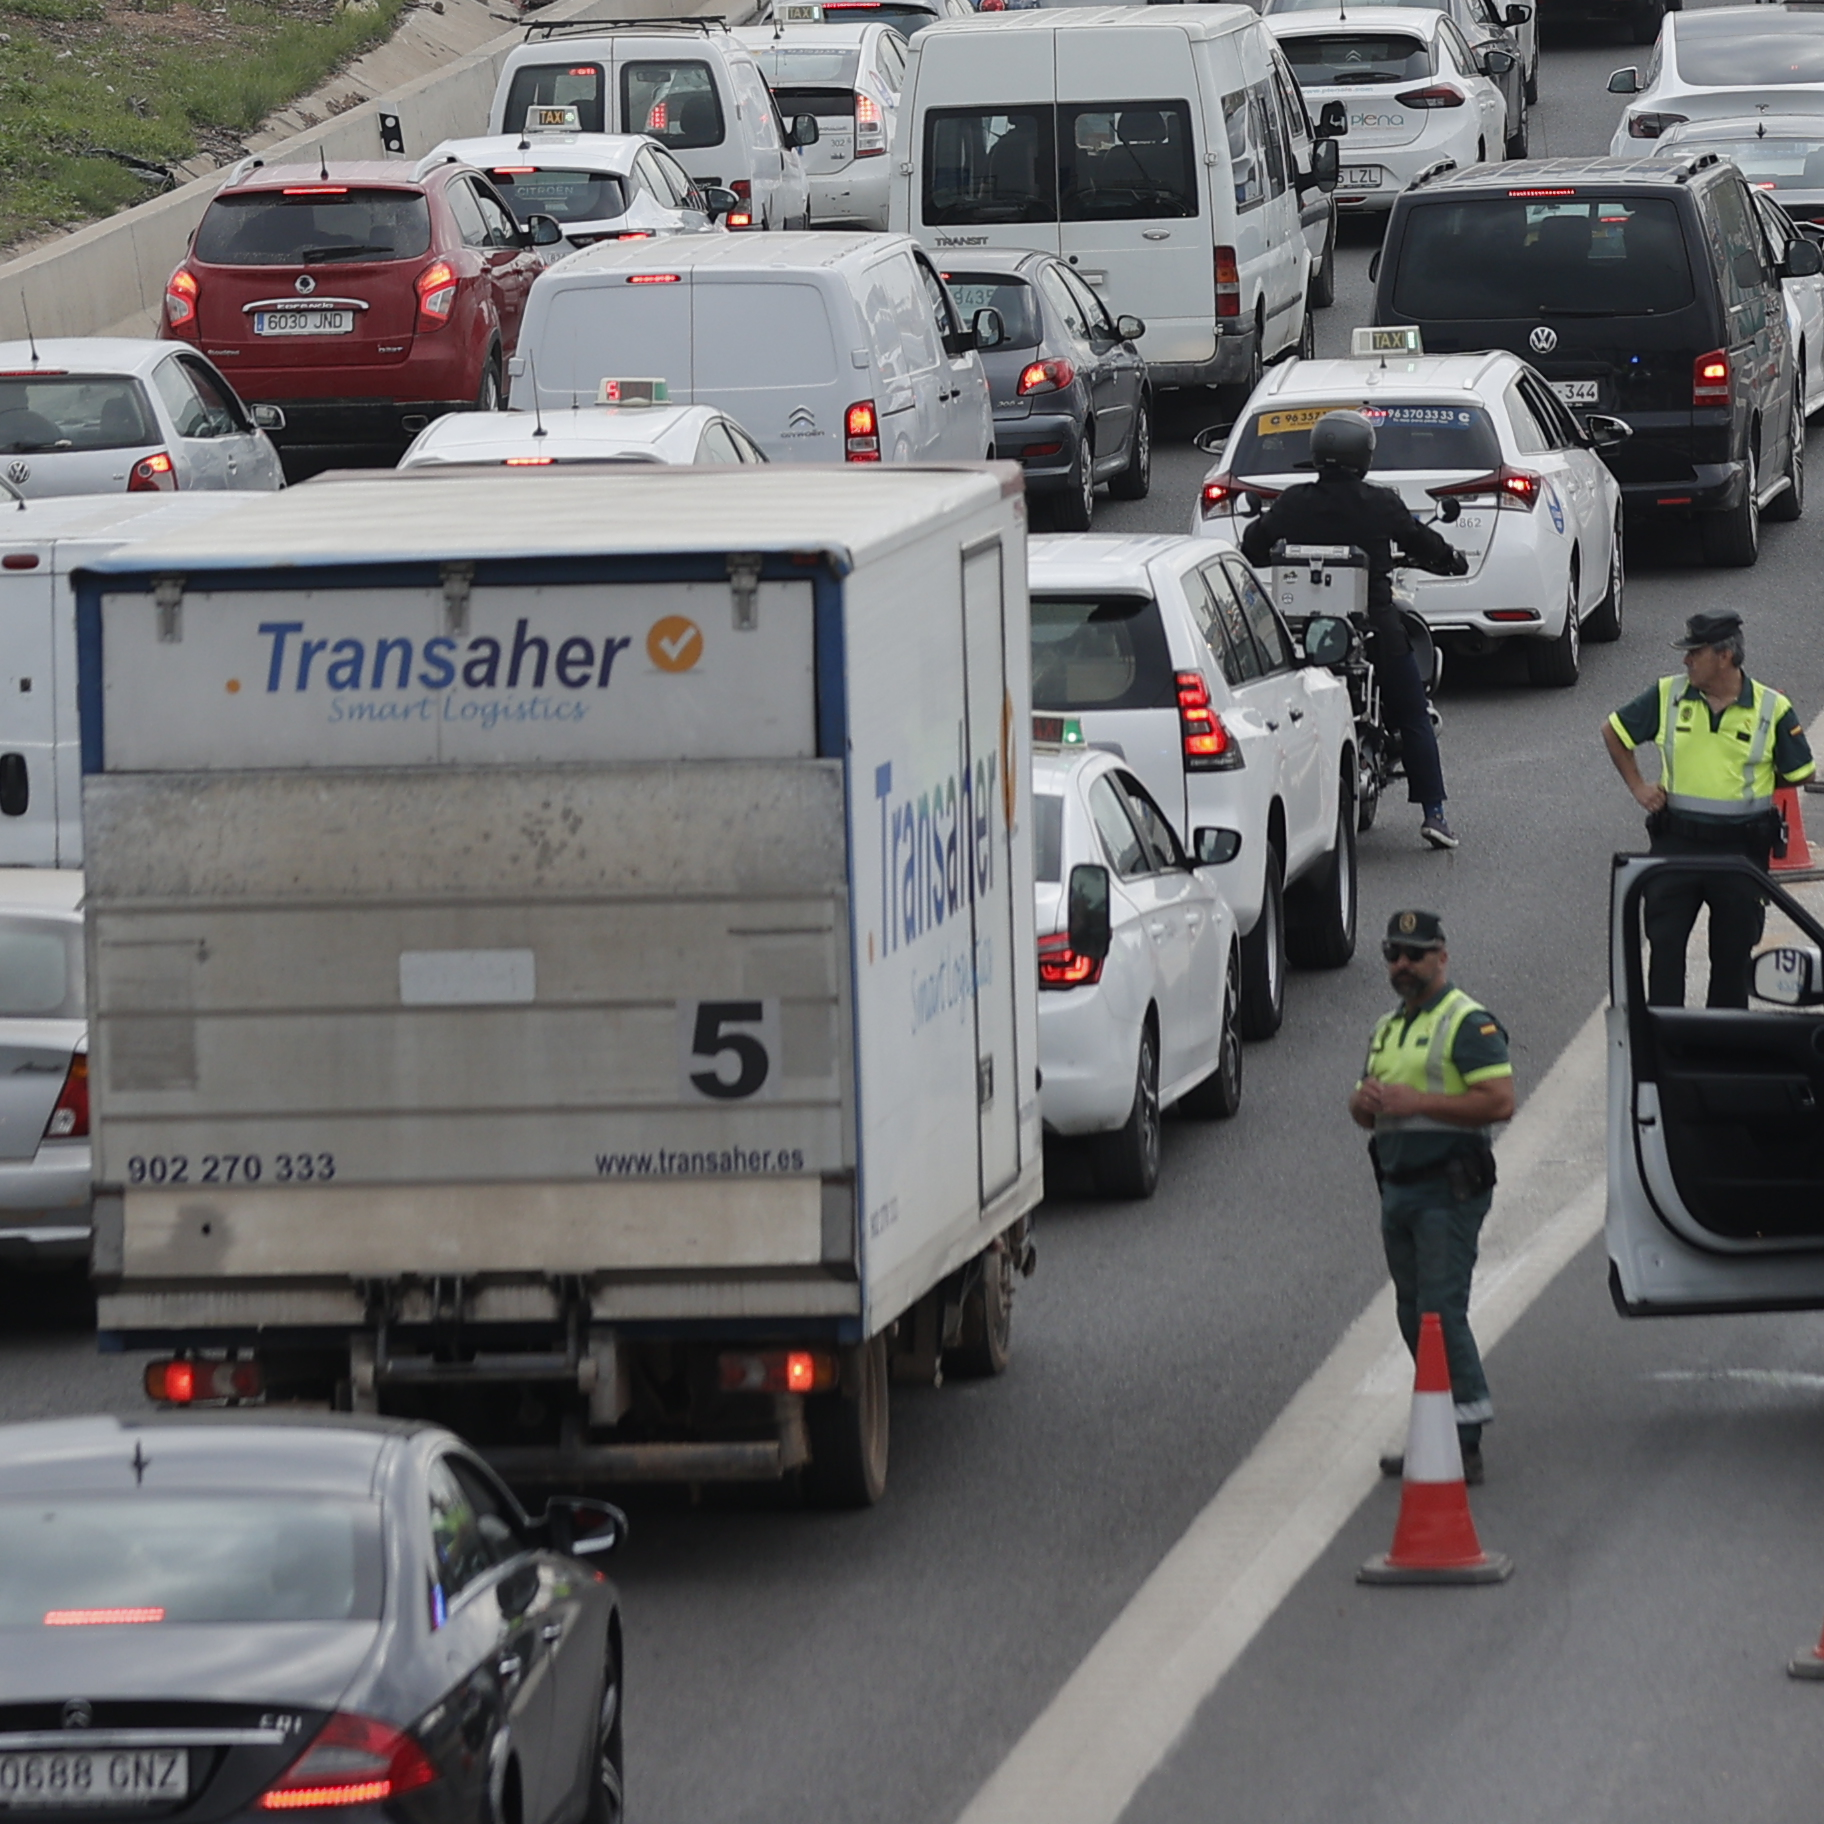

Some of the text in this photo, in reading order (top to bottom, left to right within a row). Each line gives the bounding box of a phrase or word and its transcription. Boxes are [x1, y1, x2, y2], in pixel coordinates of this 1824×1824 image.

[539, 111, 565, 124] TAXI
[1349, 170, 1378, 183] LZL
[935, 236, 989, 247] TRANSIT
[267, 313, 343, 330] 6030 JND
[1373, 332, 1406, 348] TAXI
[1285, 414, 1298, 424] 96
[1388, 409, 1455, 421] 96 370 33 33
[257, 614, 631, 695] Transaher
[326, 693, 589, 730] Smart Logistics
[876, 719, 996, 959] Transaher
[688, 1001, 769, 1099] 5
[128, 1152, 337, 1184] 902 270 333
[595, 1147, 804, 1176] www.transaher.es
[104, 1752, 190, 1791] GNZ
